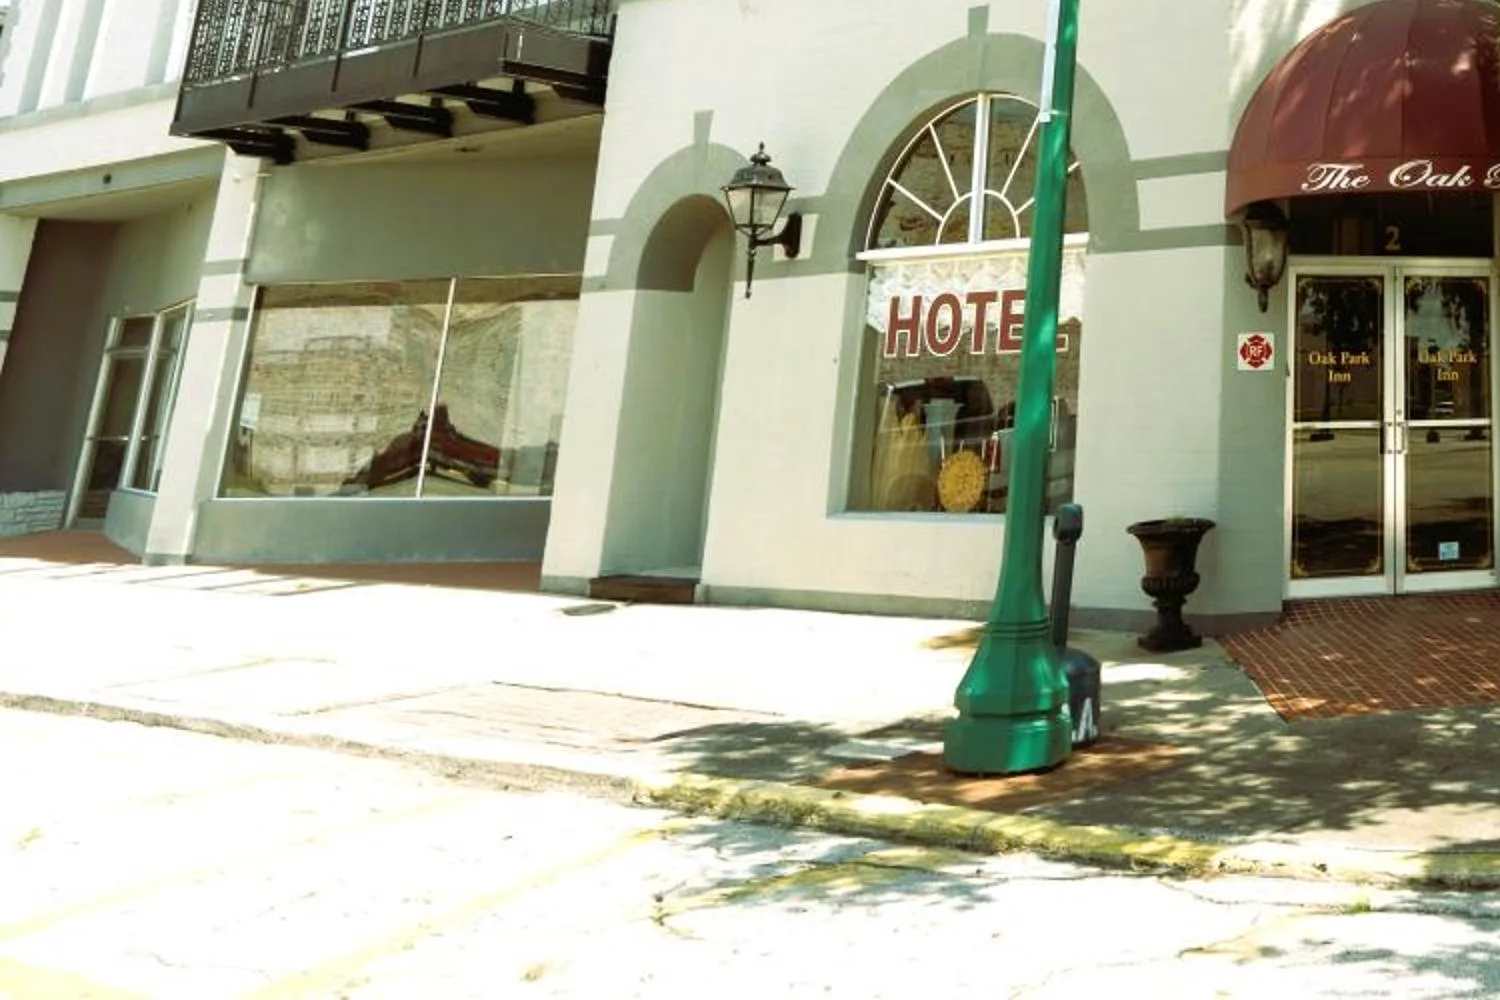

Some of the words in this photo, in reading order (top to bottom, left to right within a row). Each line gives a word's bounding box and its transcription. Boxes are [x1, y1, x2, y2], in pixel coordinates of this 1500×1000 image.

[1301, 163, 1370, 191] The
[1389, 159, 1475, 189] Oak
[1384, 225, 1401, 251] 2
[874, 289, 1069, 358] HOTE
[1249, 345, 1263, 358] RF
[1308, 351, 1336, 365] Oak
[1341, 351, 1369, 365] Park
[1448, 349, 1477, 363] Park
[1328, 369, 1351, 382] Inn
[1437, 367, 1459, 381] Inn
